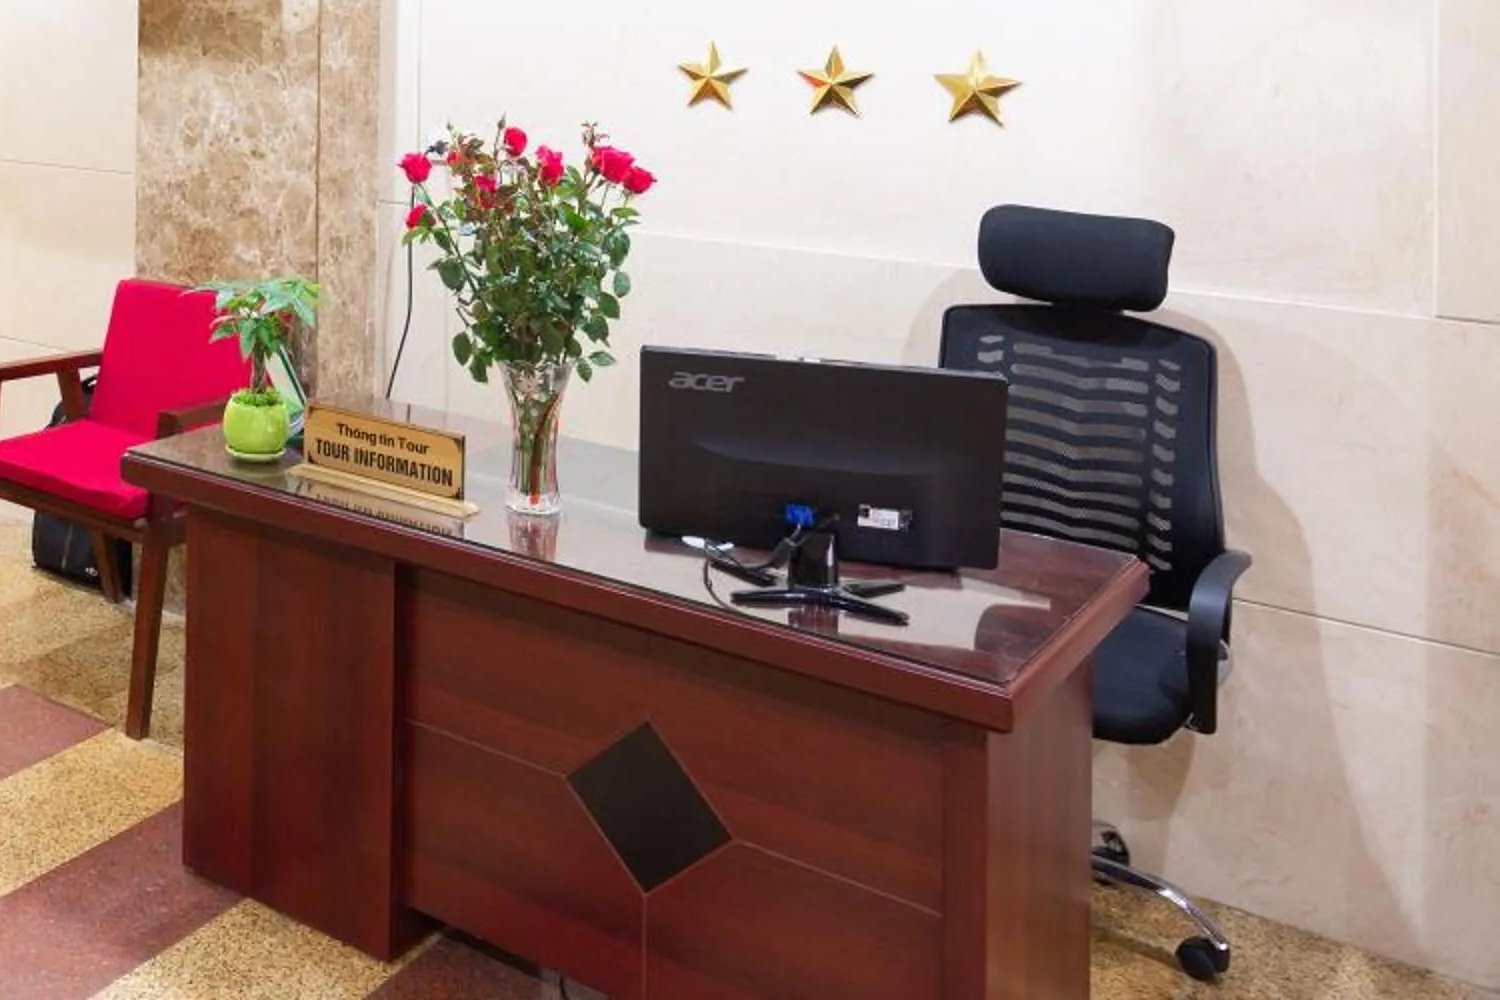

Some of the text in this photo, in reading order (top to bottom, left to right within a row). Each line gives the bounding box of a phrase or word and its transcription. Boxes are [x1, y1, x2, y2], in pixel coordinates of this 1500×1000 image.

[668, 371, 746, 393] acer
[380, 433, 395, 448] tin
[398, 437, 431, 455] Tour
[316, 439, 453, 487] TOUR INFORMATION
